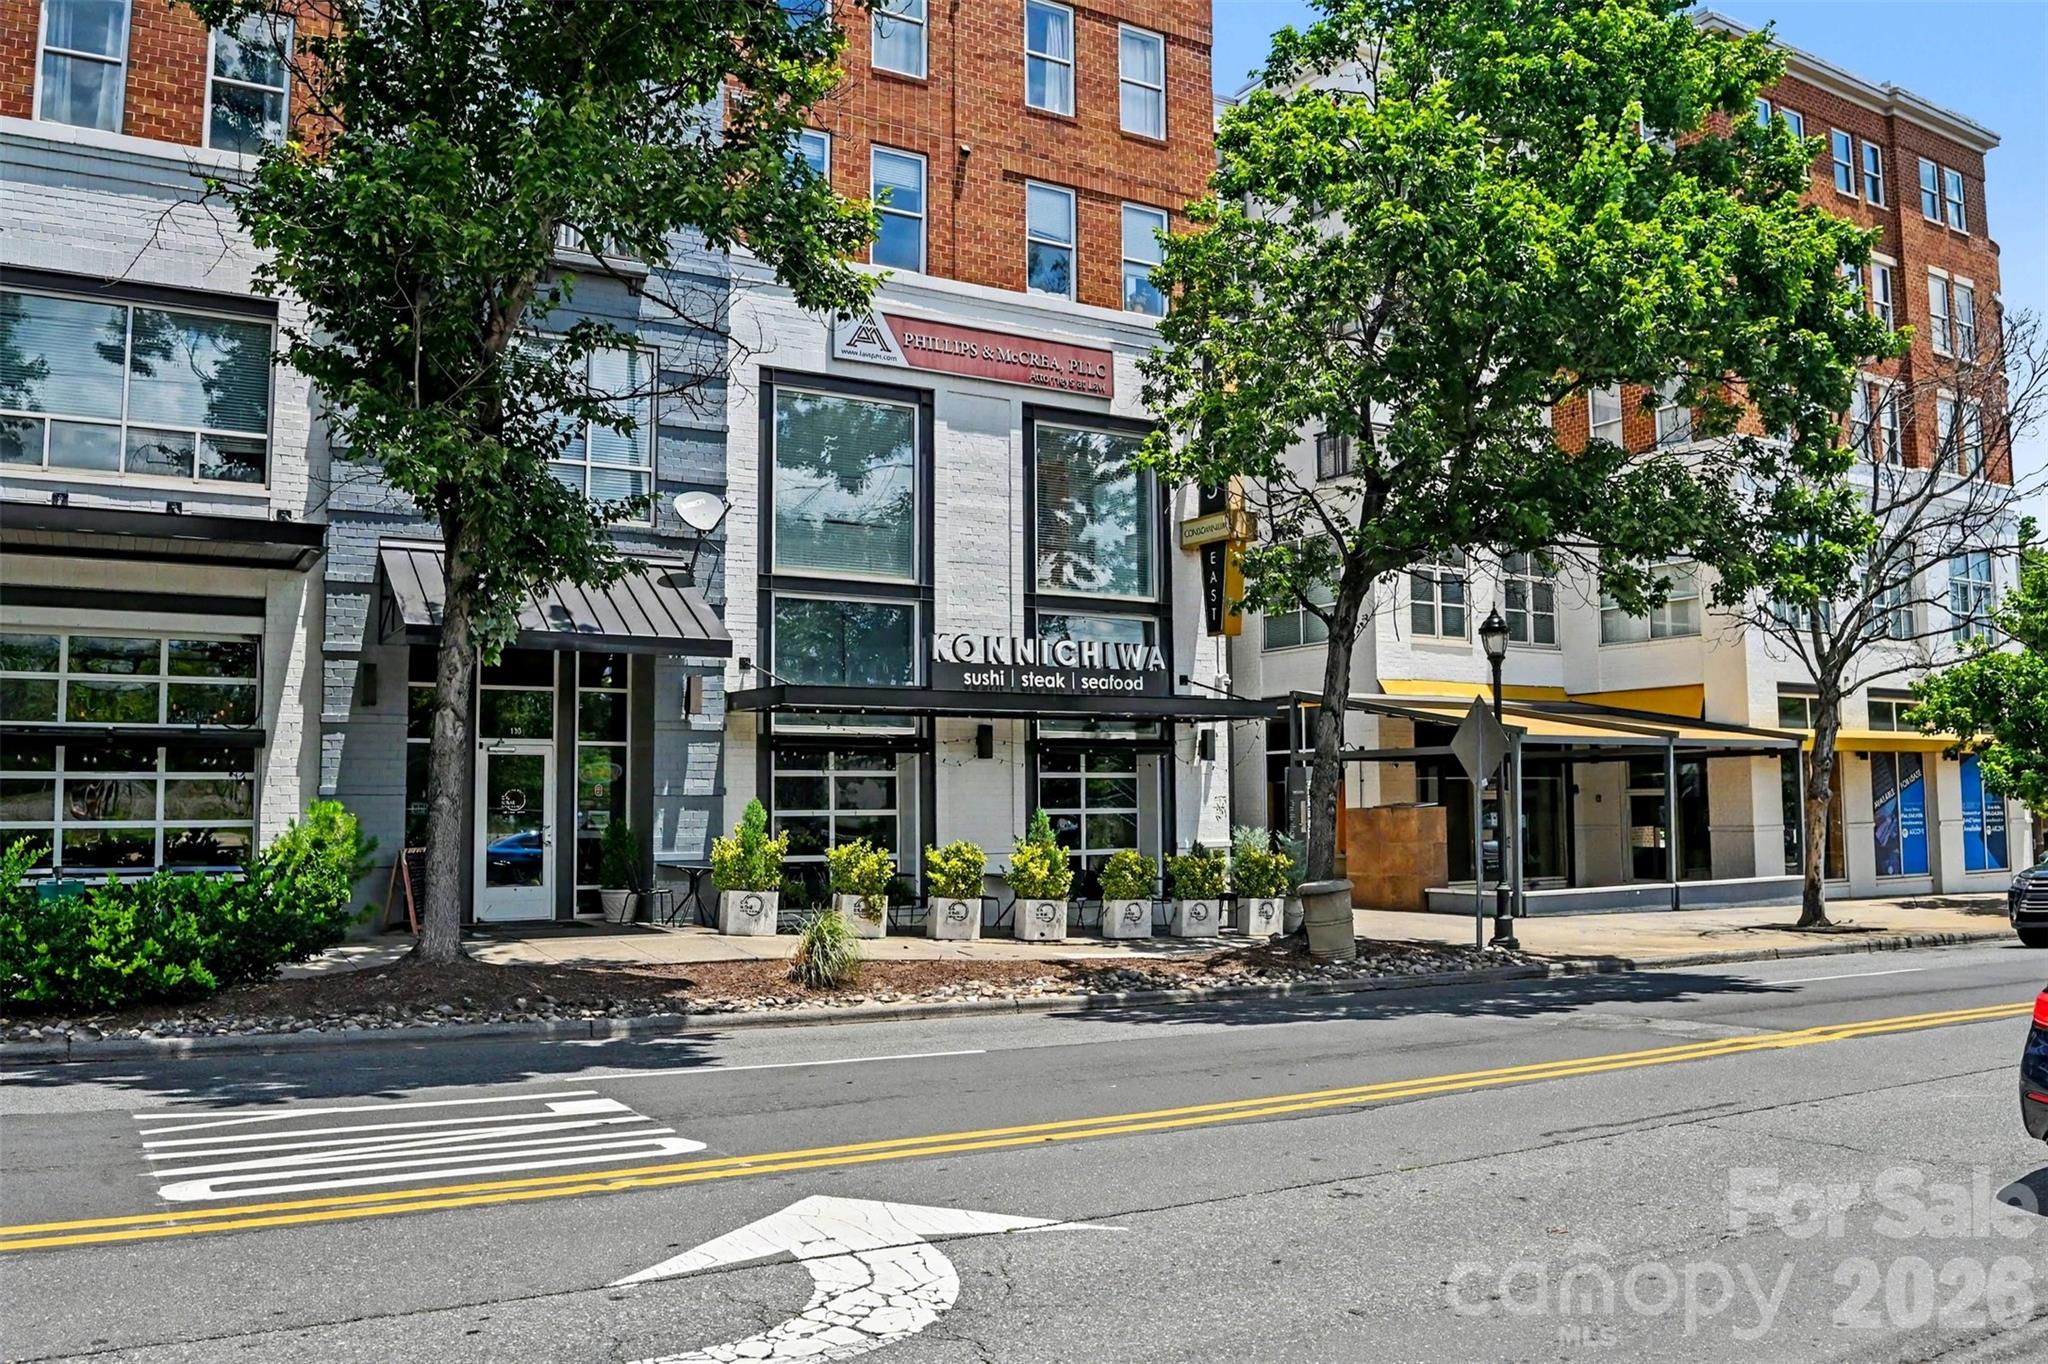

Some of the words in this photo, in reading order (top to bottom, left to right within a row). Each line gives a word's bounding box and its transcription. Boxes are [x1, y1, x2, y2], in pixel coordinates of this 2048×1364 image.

[903, 332, 978, 358] PHILLIPS
[982, 344, 994, 359] &
[1069, 359, 1107, 379] PLLC
[1029, 370, 1076, 389] Attorneys
[1077, 379, 1086, 389] at
[1088, 379, 1106, 393] Law
[1209, 551, 1218, 622] EAST
[933, 634, 1166, 671] KONNICHIWA
[963, 670, 1004, 686] sushi
[1021, 672, 1065, 688] steak
[1081, 675, 1144, 691] seafood
